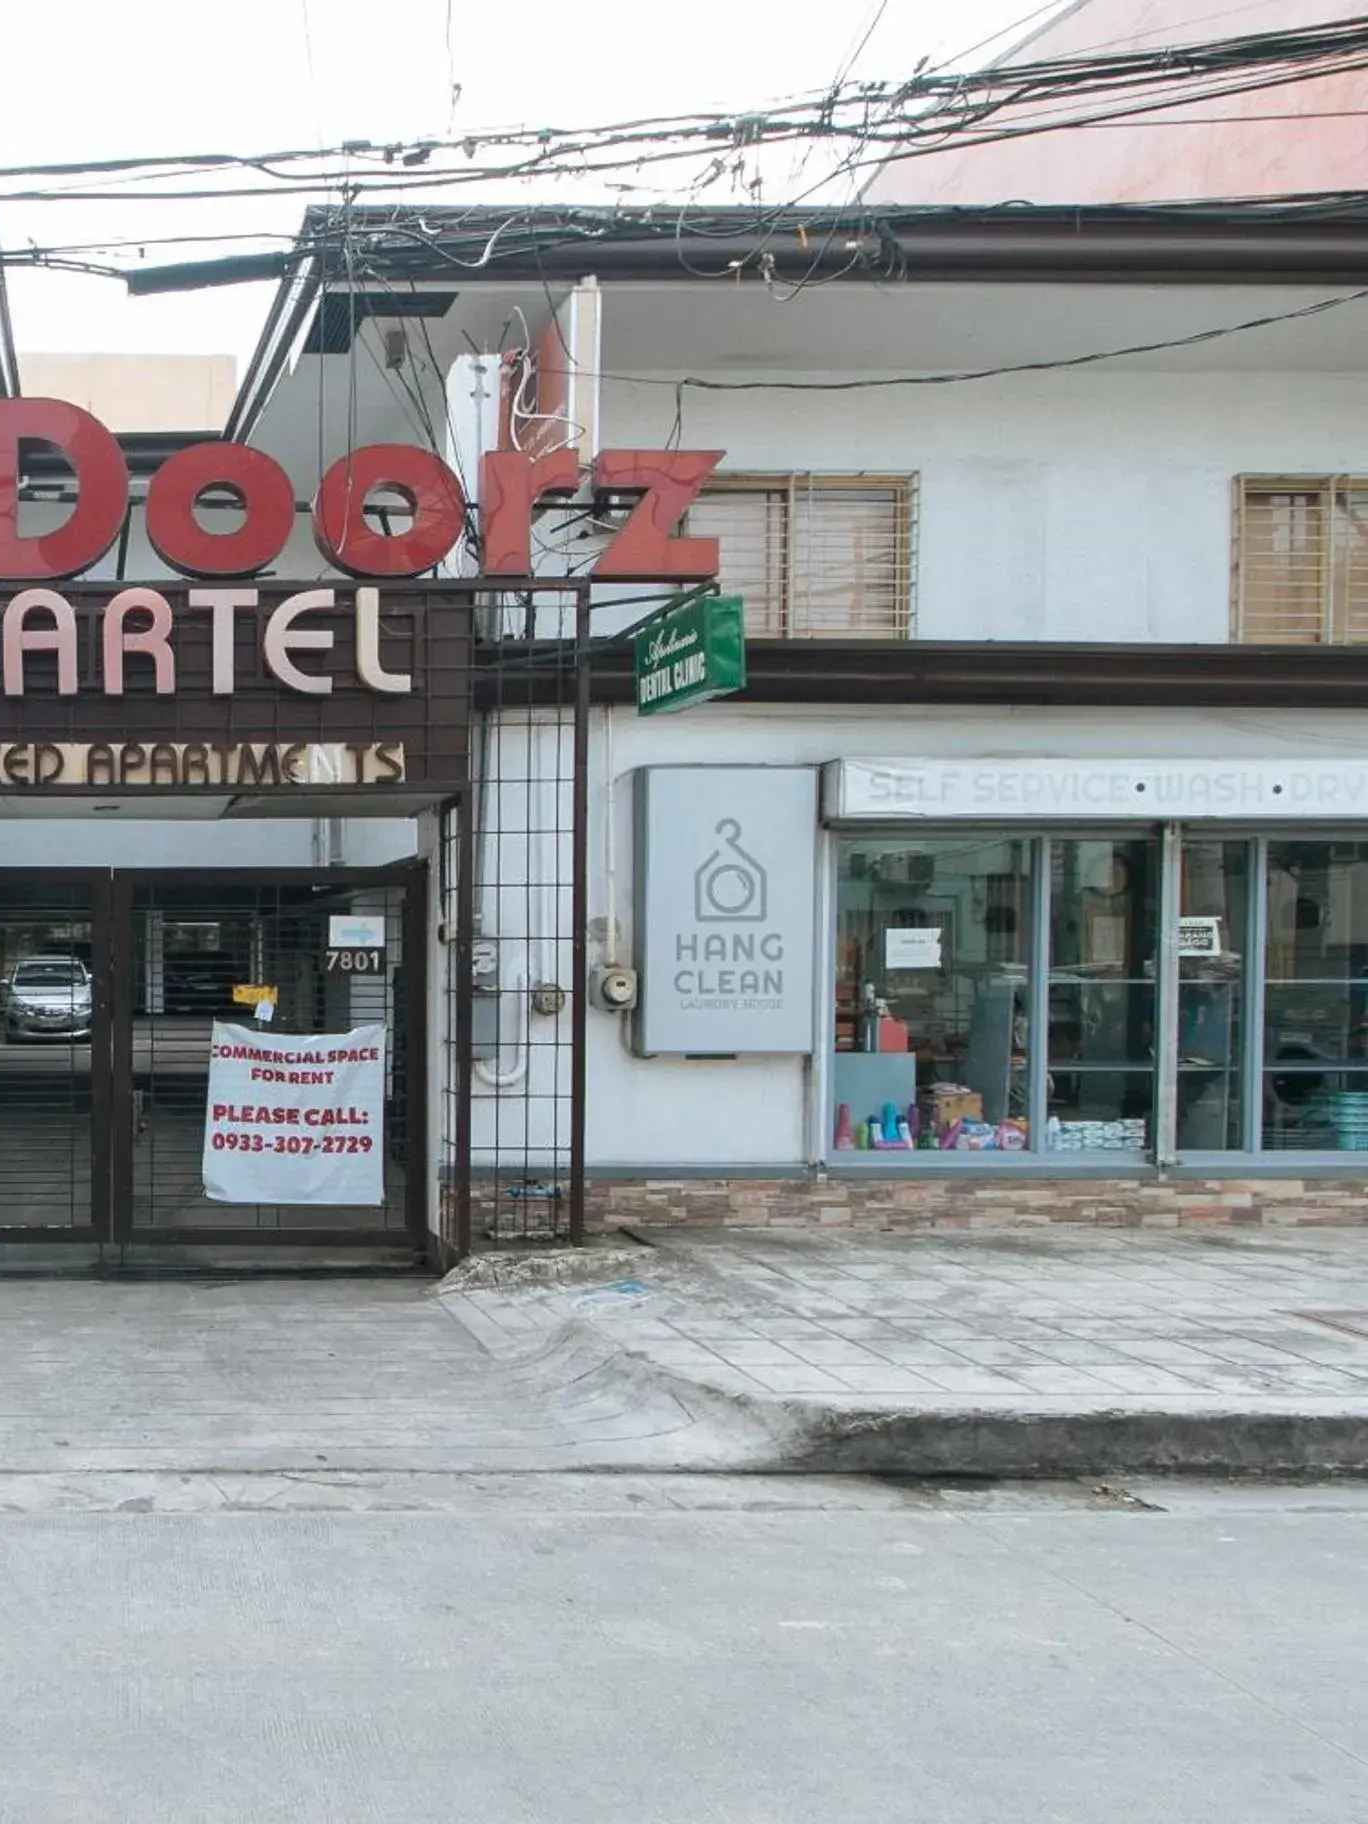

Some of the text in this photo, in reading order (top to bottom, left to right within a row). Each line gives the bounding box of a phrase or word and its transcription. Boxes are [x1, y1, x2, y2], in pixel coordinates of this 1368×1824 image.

[639, 652, 706, 704] DENTAL CLINIC
[86, 743, 405, 784] APARTMENTS
[869, 772, 961, 803] SELF
[973, 773, 1130, 804] SERVICE
[1154, 773, 1265, 803] WASH
[675, 933, 784, 962] HANG
[326, 951, 380, 971] 7801
[674, 970, 784, 995] CLEAN
[327, 1048, 379, 1063] SPACE
[251, 1068, 334, 1084] FOR RENT
[213, 1104, 369, 1126] PLEASE CALL:
[212, 1132, 373, 1154] 0933-307-2729
